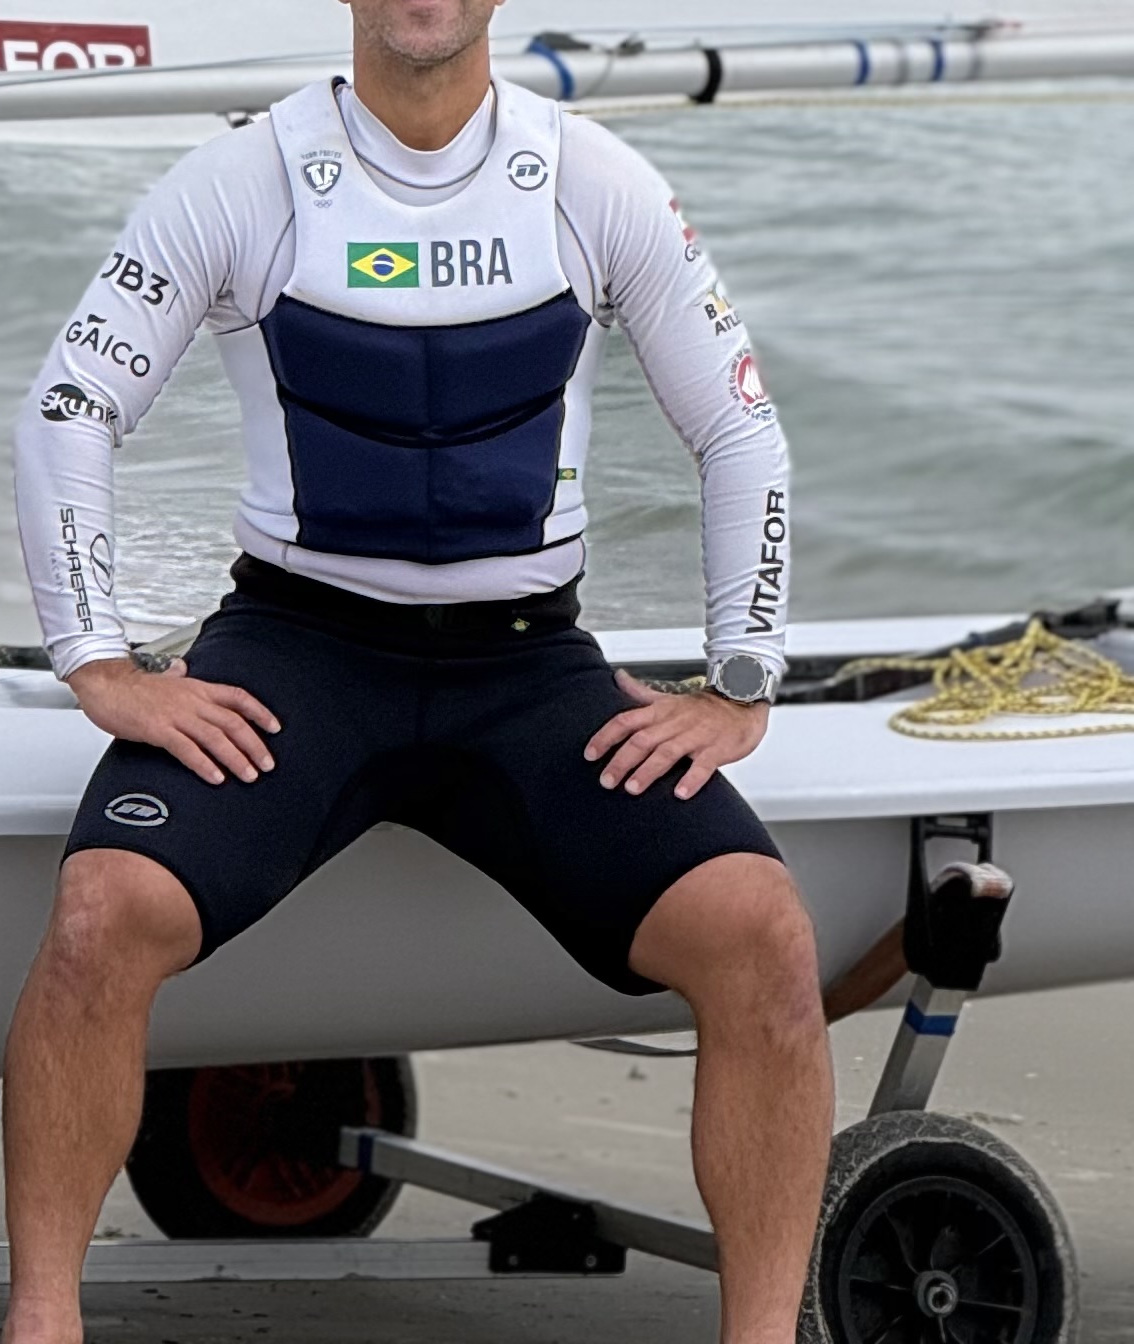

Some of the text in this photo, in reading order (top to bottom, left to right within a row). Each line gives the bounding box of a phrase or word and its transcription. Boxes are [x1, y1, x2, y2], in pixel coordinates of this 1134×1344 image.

[100, 252, 169, 306] JB3
[430, 237, 513, 288] BRA
[60, 508, 94, 633] SCHAEFER
[746, 489, 786, 635] VITAFOR
